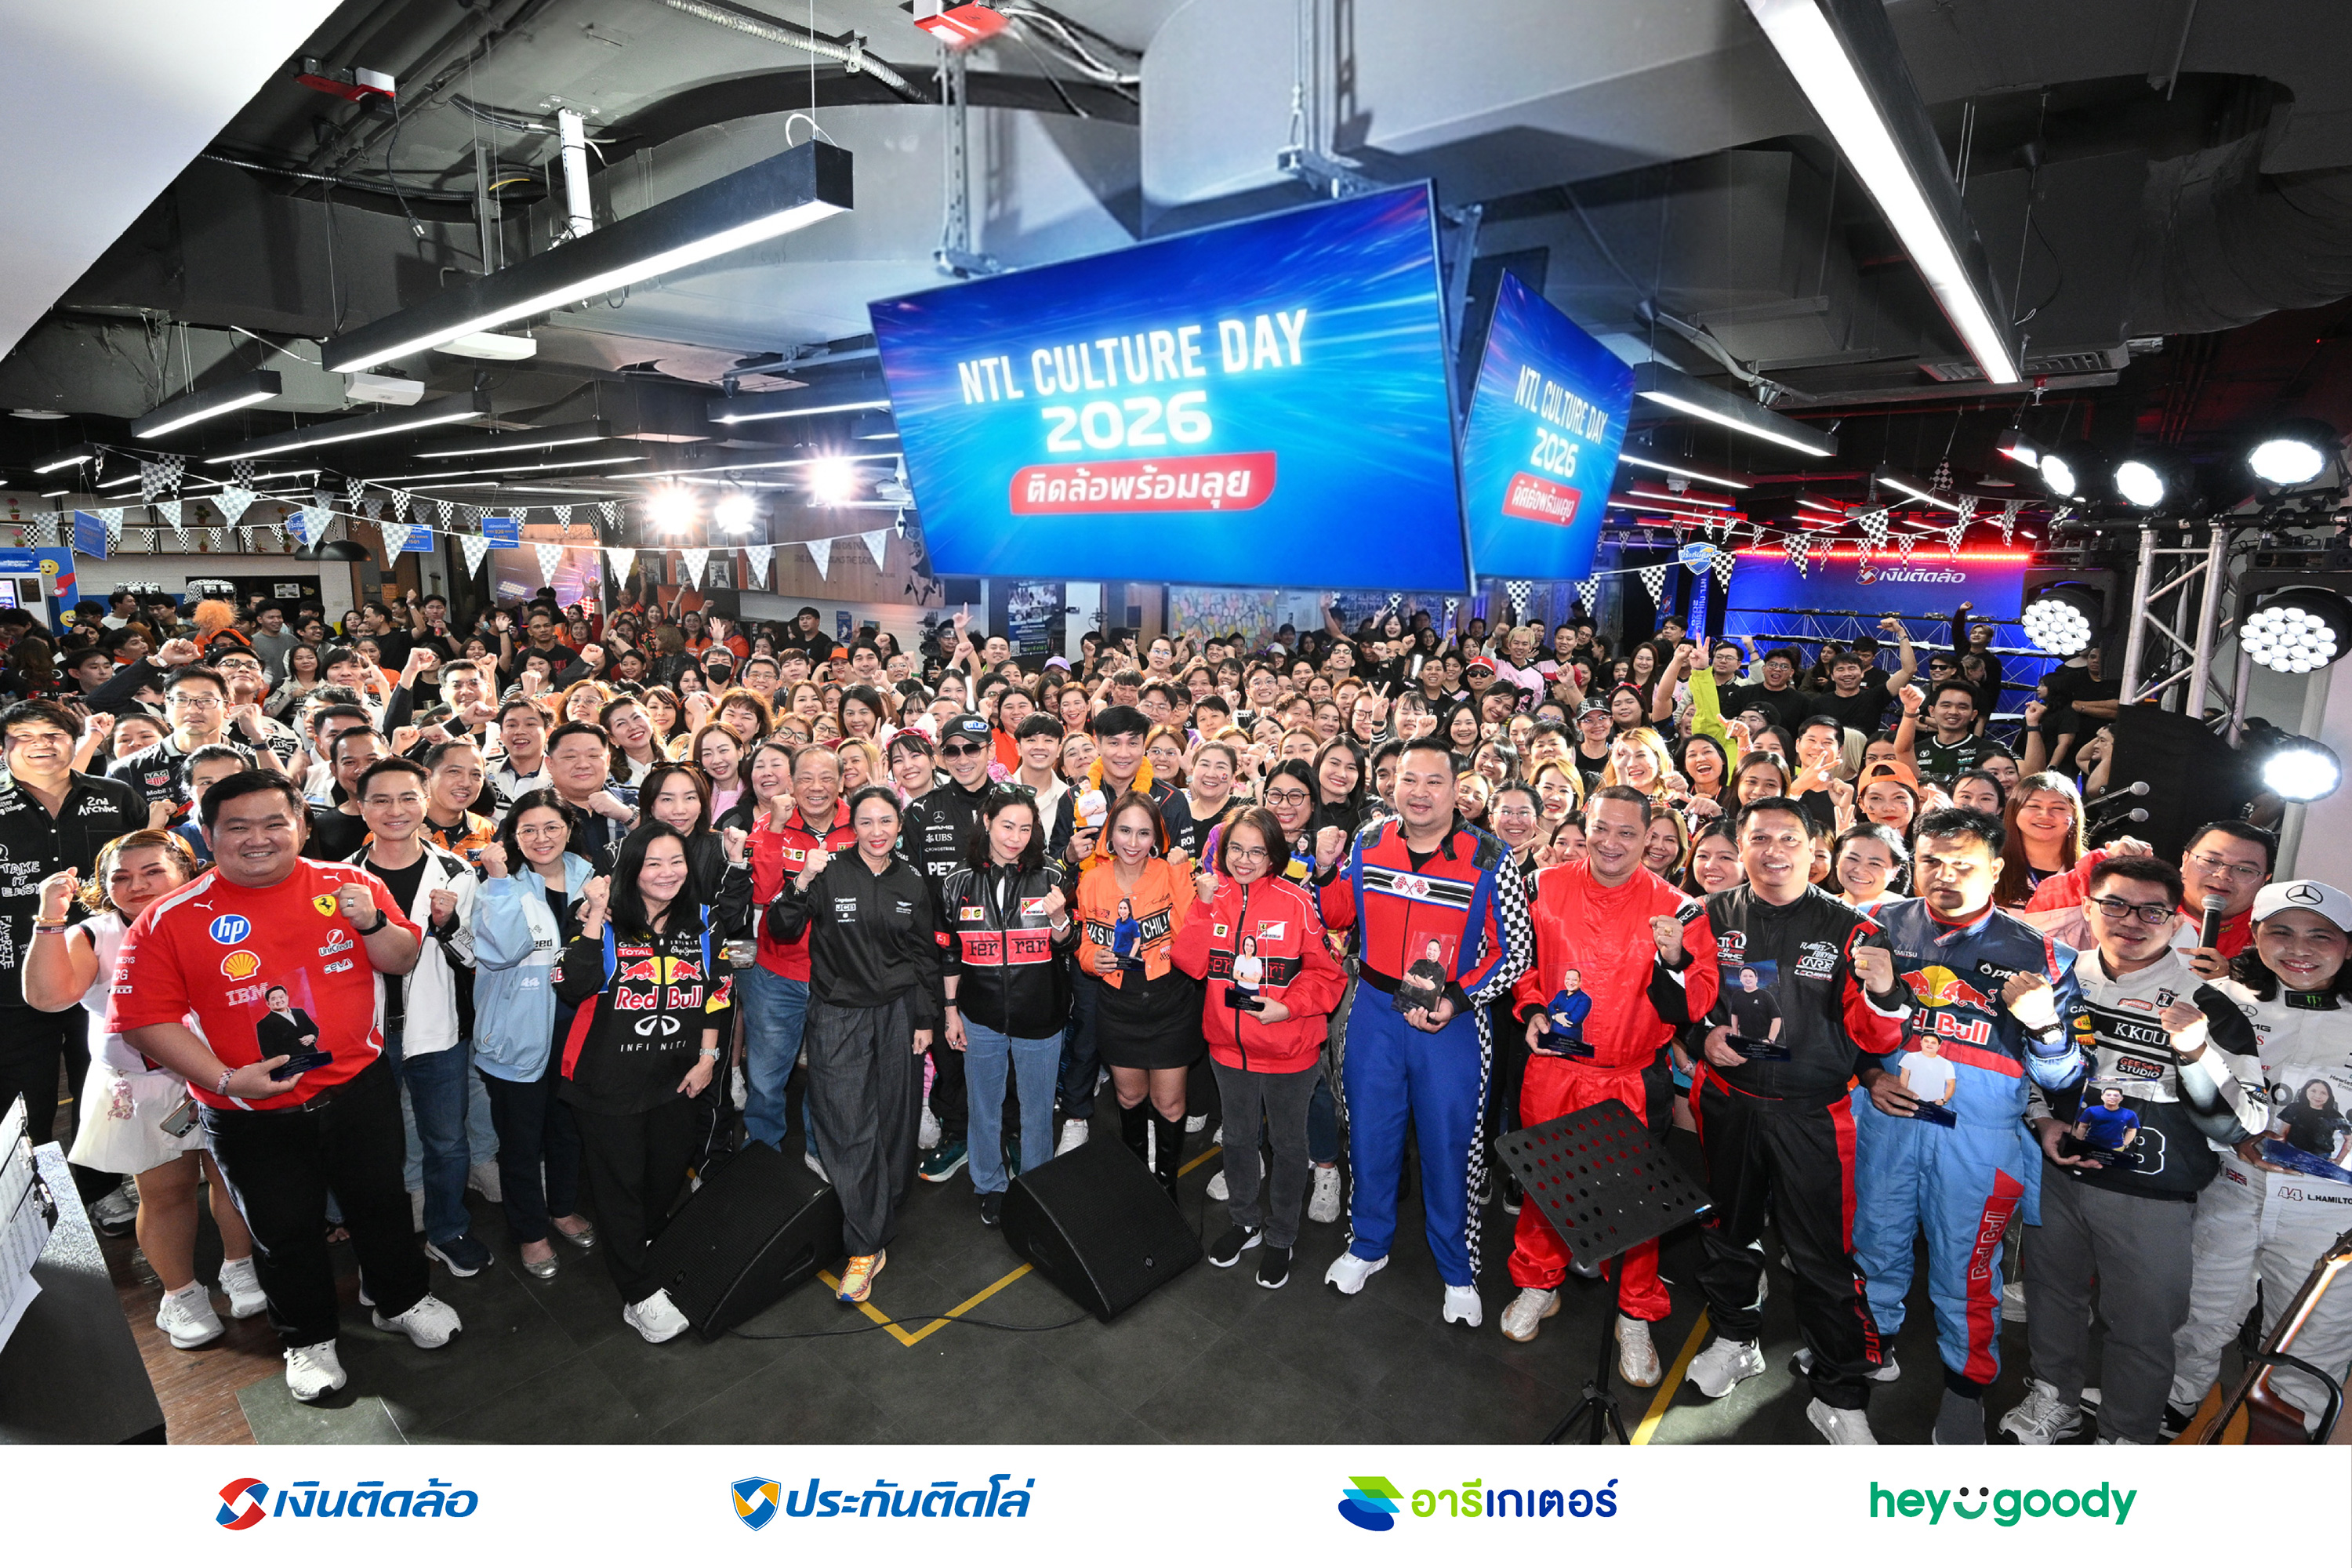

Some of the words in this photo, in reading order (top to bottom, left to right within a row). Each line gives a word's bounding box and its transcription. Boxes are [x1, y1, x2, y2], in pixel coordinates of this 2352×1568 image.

[958, 356, 1024, 405] NTL
[1032, 325, 1206, 395] CULTURE
[1218, 309, 1308, 373] DAY
[1515, 365, 1541, 412] NTL
[1541, 380, 1588, 436] CULTURE
[1585, 405, 1608, 445] DAY
[1041, 390, 1213, 453] 2026
[1530, 426, 1579, 477] 2026
[1026, 465, 1251, 509] ติดล้อพร้อมลุย
[1879, 568, 1966, 583] เงินติดล้อ
[145, 769, 169, 779] TAG
[146, 788, 165, 797] Mobil
[78, 805, 119, 816] Archive
[86, 797, 109, 807] 2nd
[935, 833, 953, 842] UBS
[1, 861, 40, 875] TAKE
[12, 876, 27, 887] IT
[217, 913, 245, 943] hp
[318, 939, 354, 956] UniCredit
[966, 939, 1000, 956] Fer
[1893, 949, 1918, 958] EMITSU
[521, 977, 540, 987] 44
[225, 982, 268, 1006] IBM
[615, 985, 659, 1010] Red
[666, 985, 703, 1010] Bull
[1934, 1011, 1992, 1046] Bull
[2114, 1022, 2171, 1047] KKOU
[2252, 1024, 2271, 1033] MG
[2118, 1065, 2160, 1078] STUDIO
[2278, 1186, 2303, 1201] 44
[1981, 1210, 2007, 1243] Bull
[1971, 1247, 1992, 1279] Red
